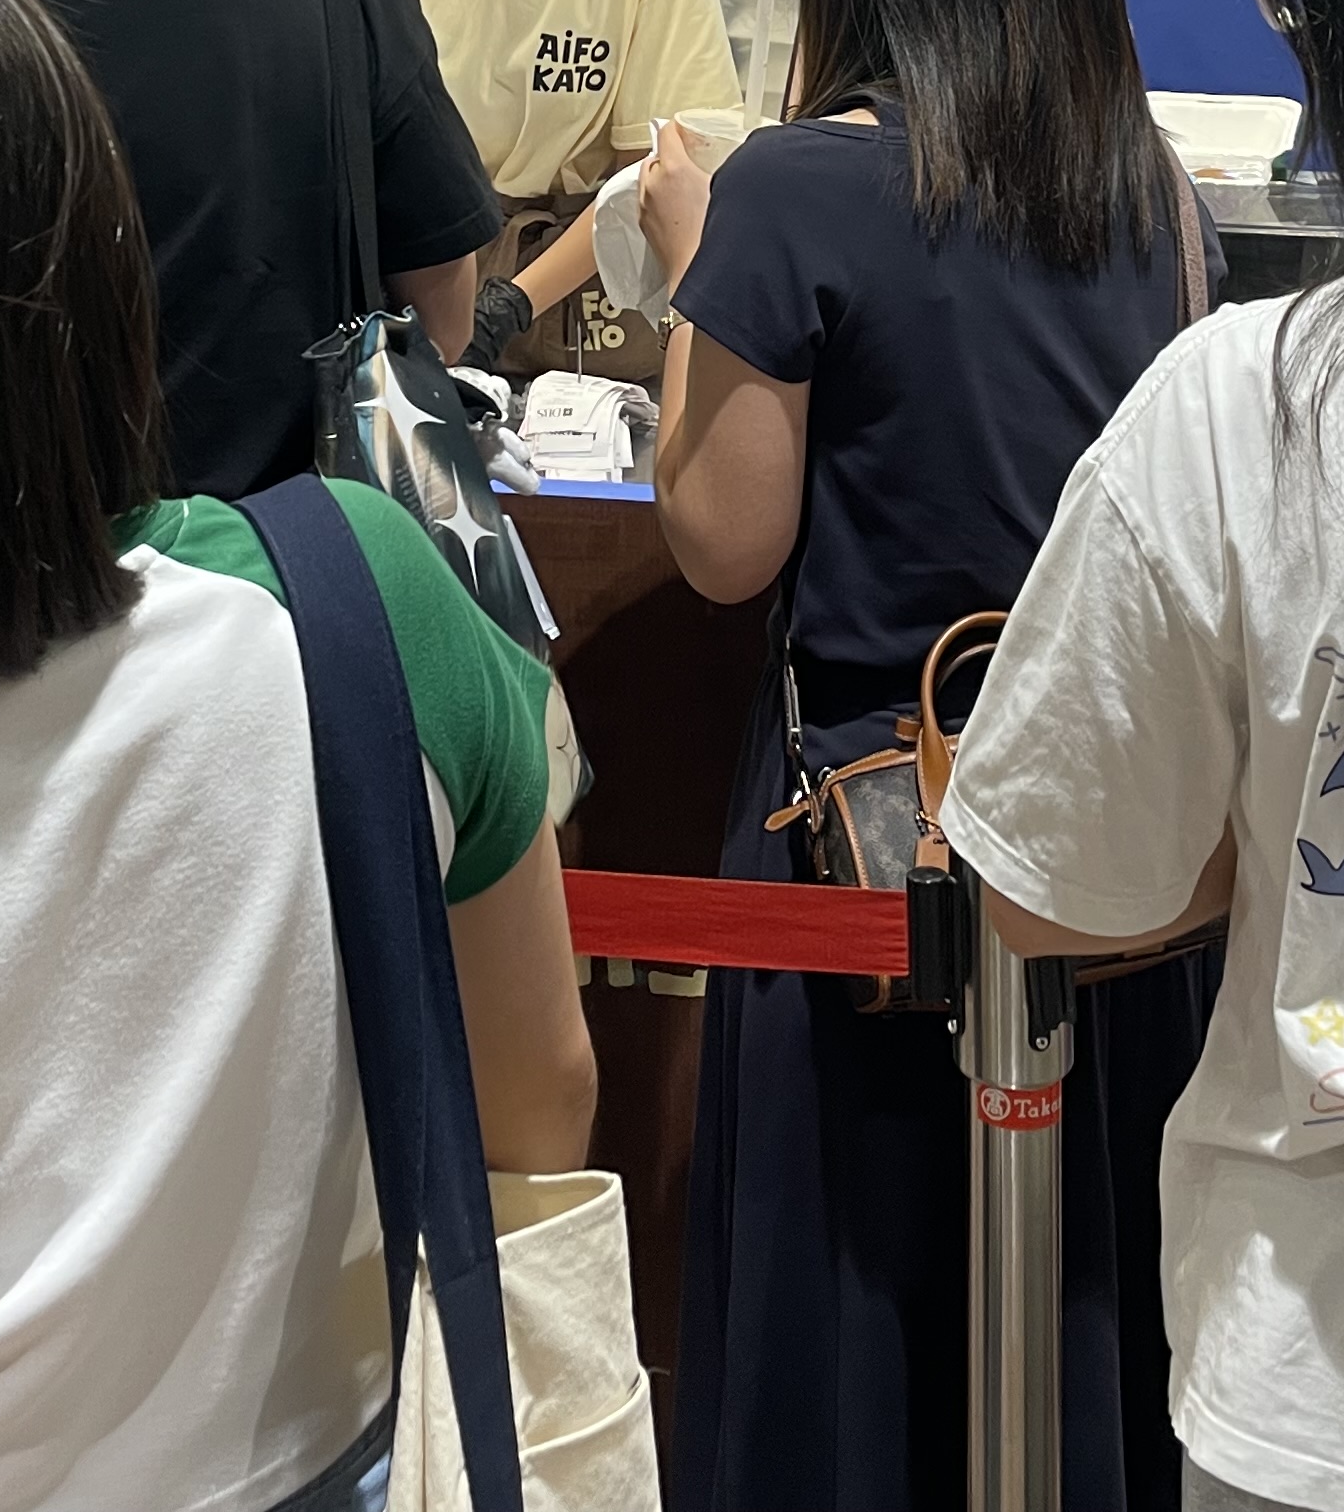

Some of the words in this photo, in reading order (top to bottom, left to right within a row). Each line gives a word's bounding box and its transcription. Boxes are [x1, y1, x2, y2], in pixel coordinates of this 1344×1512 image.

[533, 64, 606, 93] KATO
[581, 291, 623, 320] FO
[583, 320, 625, 351] TO
